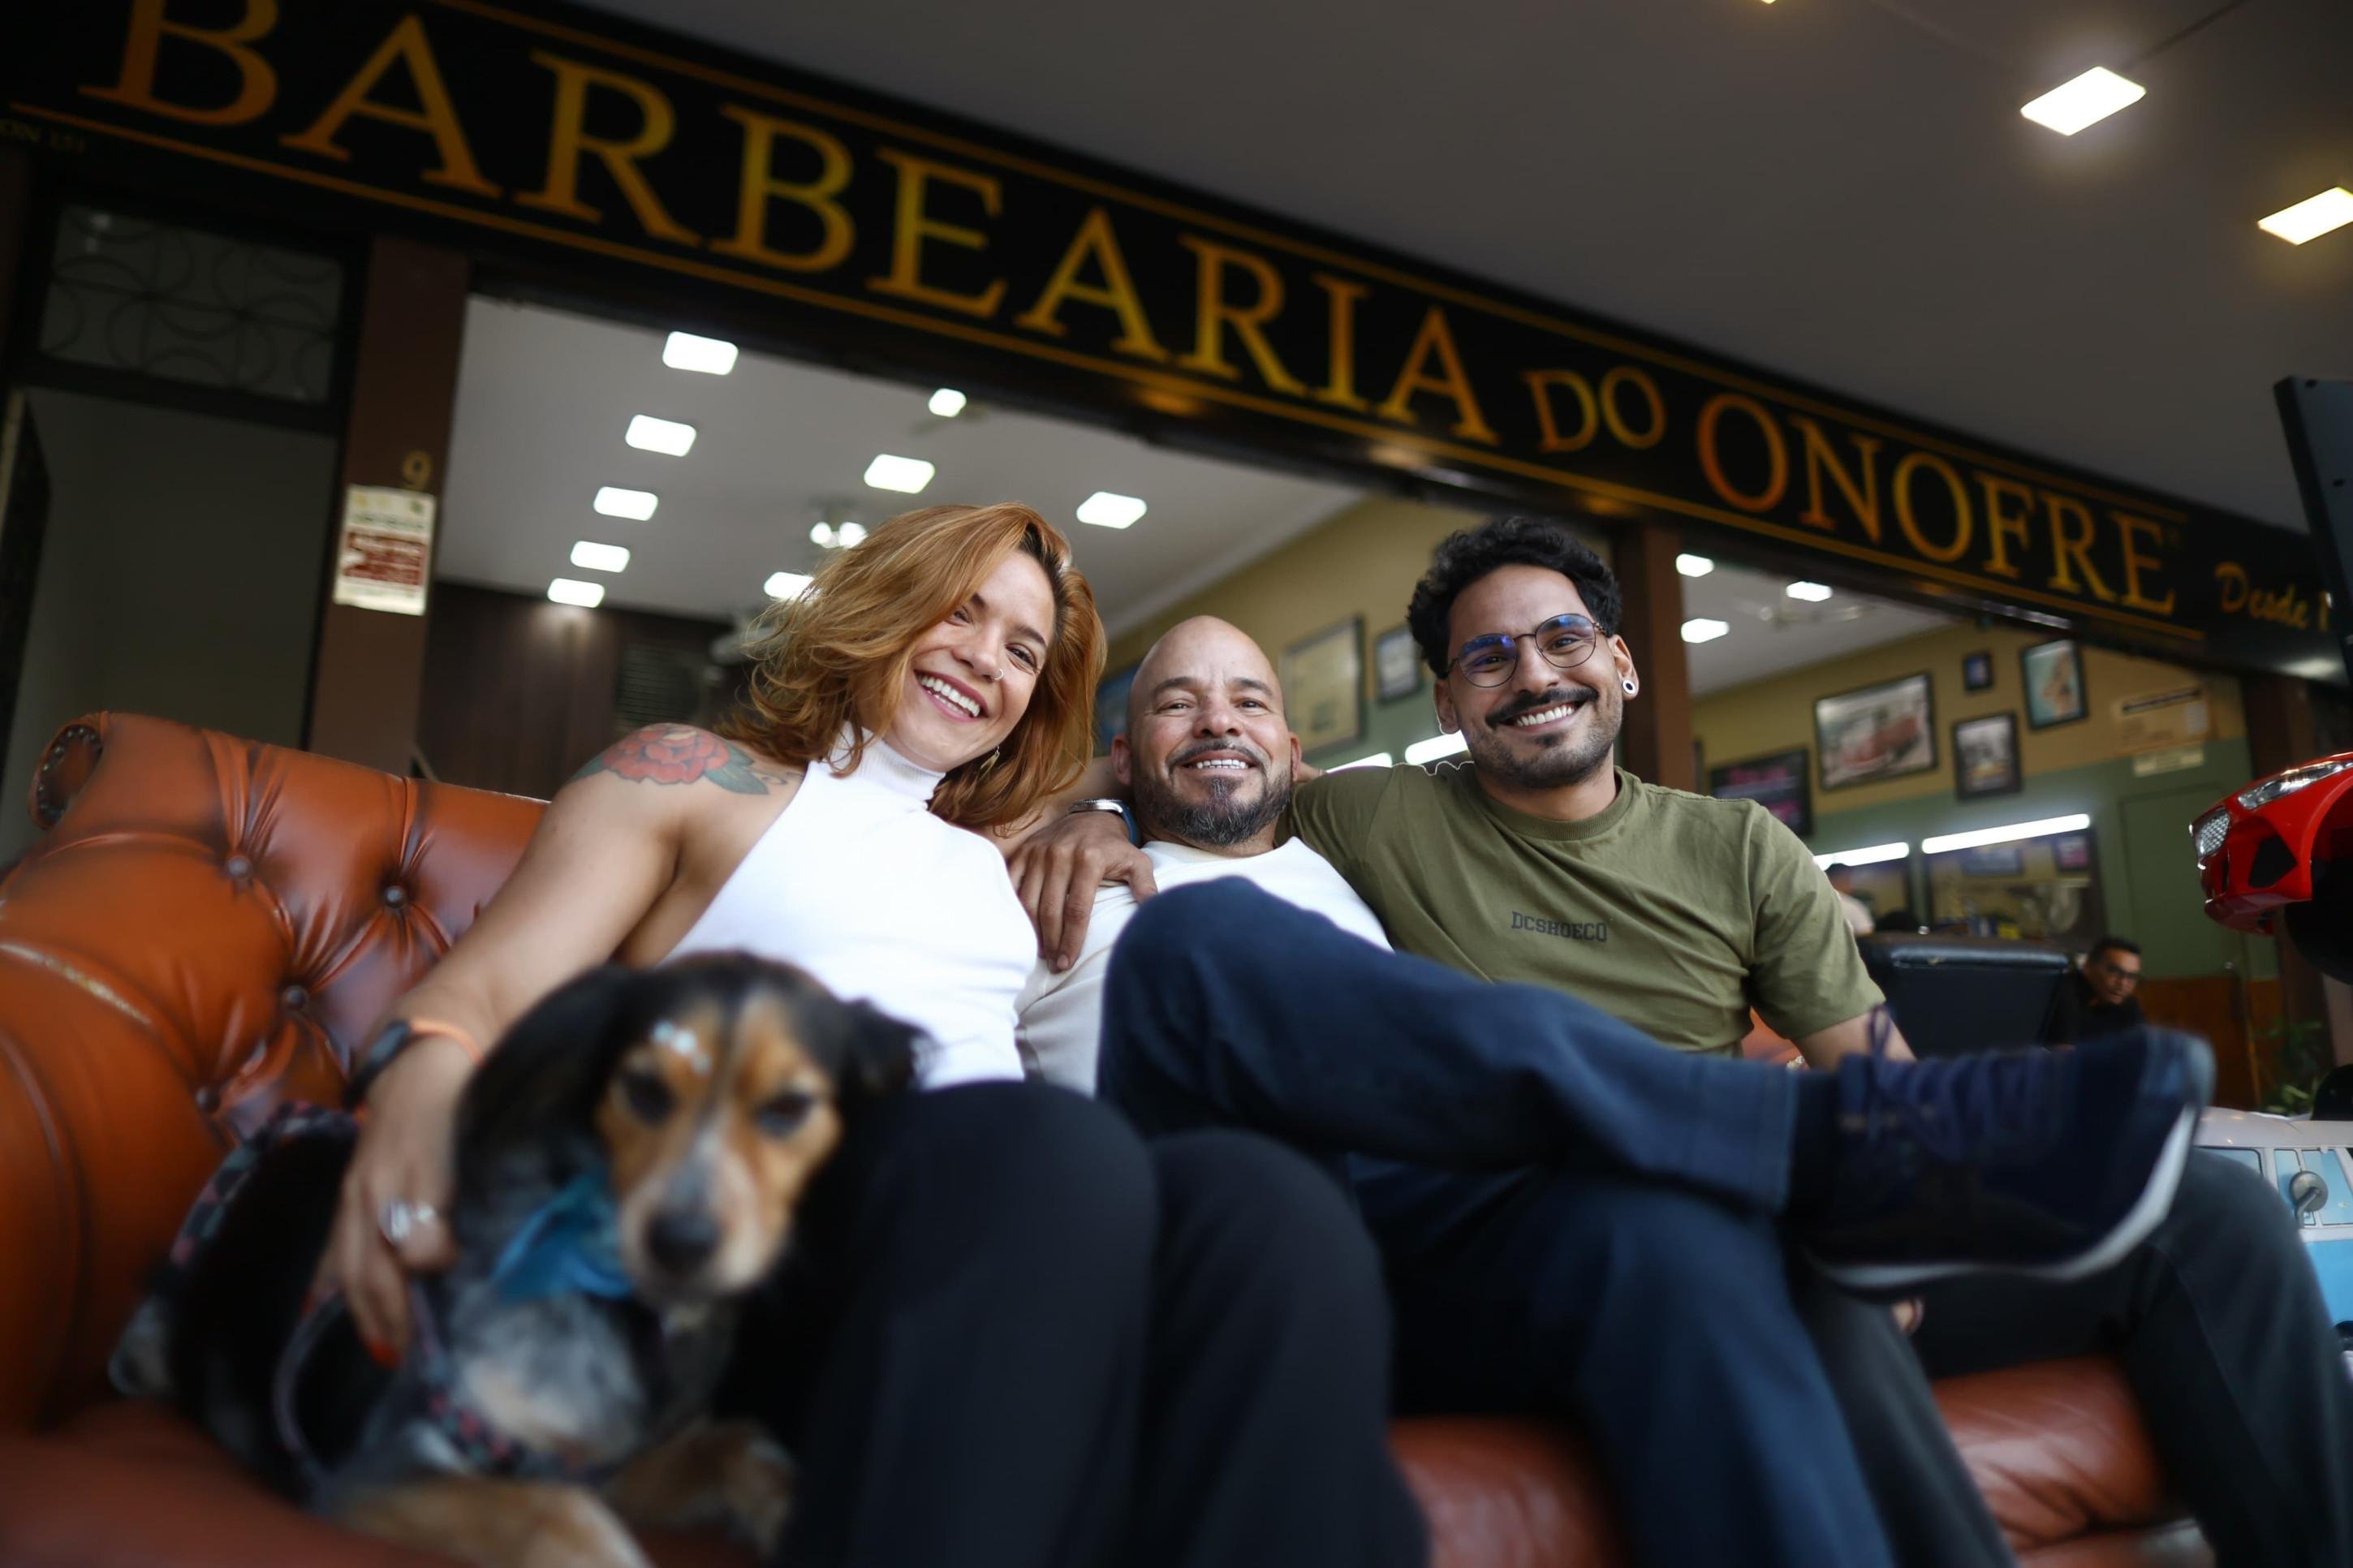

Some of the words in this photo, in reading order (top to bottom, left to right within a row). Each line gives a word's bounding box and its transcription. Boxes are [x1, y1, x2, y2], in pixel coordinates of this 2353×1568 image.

[79, 0, 1500, 446] BARBEARIA
[1523, 365, 1666, 451] DO
[1696, 393, 2175, 616] ONOFRE
[1510, 910, 1607, 942] DCSHOECO
